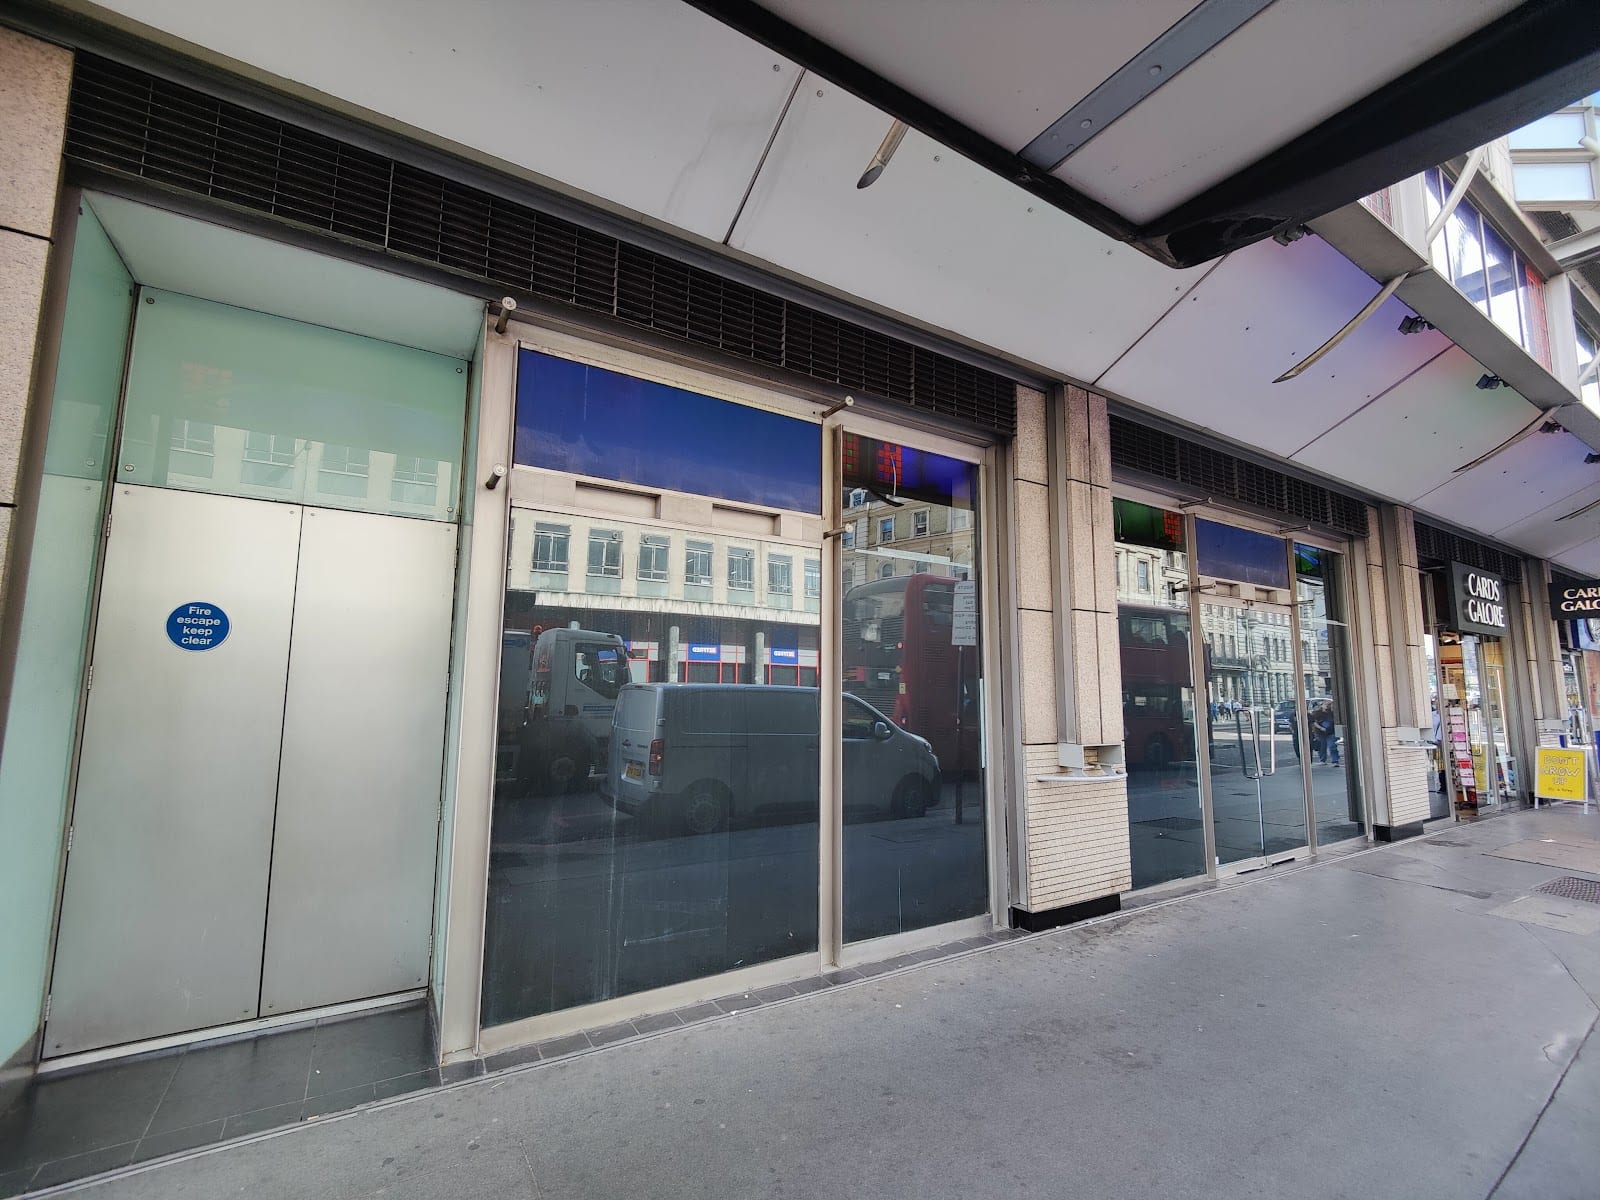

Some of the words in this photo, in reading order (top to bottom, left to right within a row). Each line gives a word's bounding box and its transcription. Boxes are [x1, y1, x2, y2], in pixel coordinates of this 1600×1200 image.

[1468, 573, 1500, 601] CARDS
[1563, 587, 1600, 599] CAR
[188, 606, 211, 615] Fire
[1560, 599, 1600, 611] GALO
[1468, 599, 1505, 627] GALORE
[177, 617, 220, 626] escape
[182, 626, 213, 636] keep
[181, 636, 212, 645] clear
